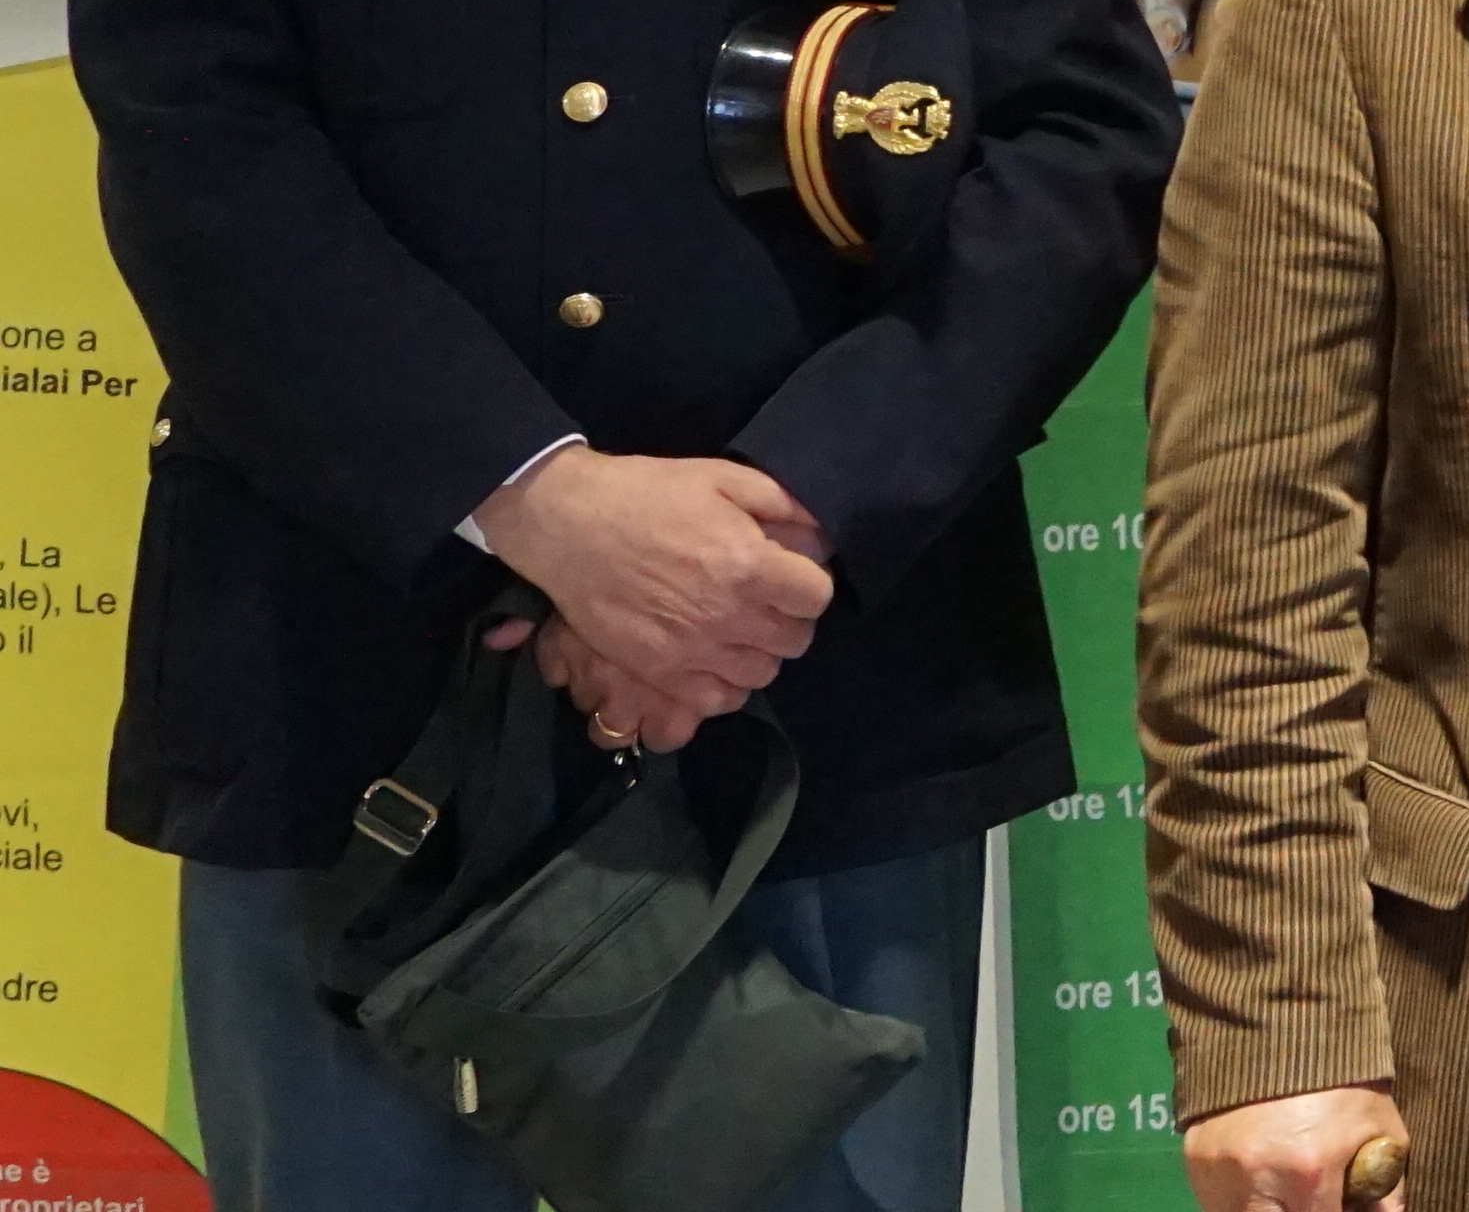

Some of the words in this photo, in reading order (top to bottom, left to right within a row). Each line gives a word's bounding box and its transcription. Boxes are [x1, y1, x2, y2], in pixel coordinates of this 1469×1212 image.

[77, 329, 97, 352] a
[81, 368, 139, 398] Per
[20, 537, 61, 569] La
[1043, 522, 1100, 553] ore
[75, 584, 117, 616] Le
[18, 625, 34, 654] il
[1047, 791, 1106, 822] ore
[1055, 980, 1113, 1010] ore
[1058, 1103, 1116, 1135] ore
